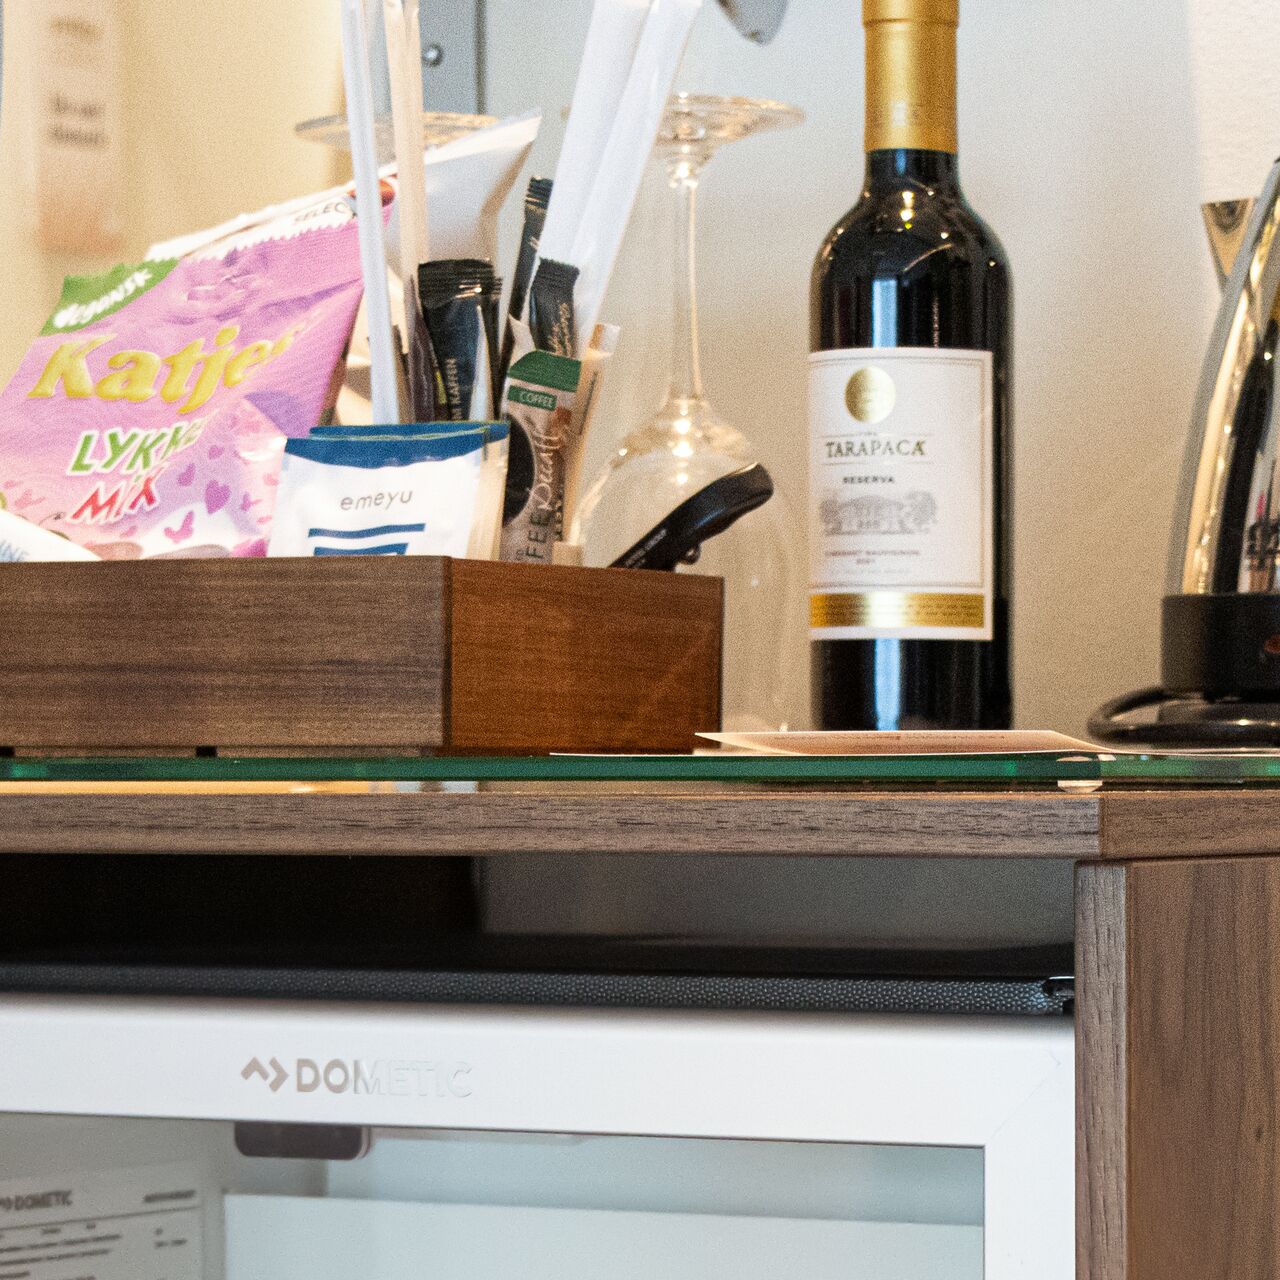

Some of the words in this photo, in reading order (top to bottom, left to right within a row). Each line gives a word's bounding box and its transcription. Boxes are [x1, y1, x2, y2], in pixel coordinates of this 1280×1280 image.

[519, 390, 555, 408] COFFEE
[841, 475, 896, 485] RESERVA
[340, 489, 414, 511] emeyu
[525, 512, 550, 560] FEE
[296, 1057, 473, 1098] DOMETIC
